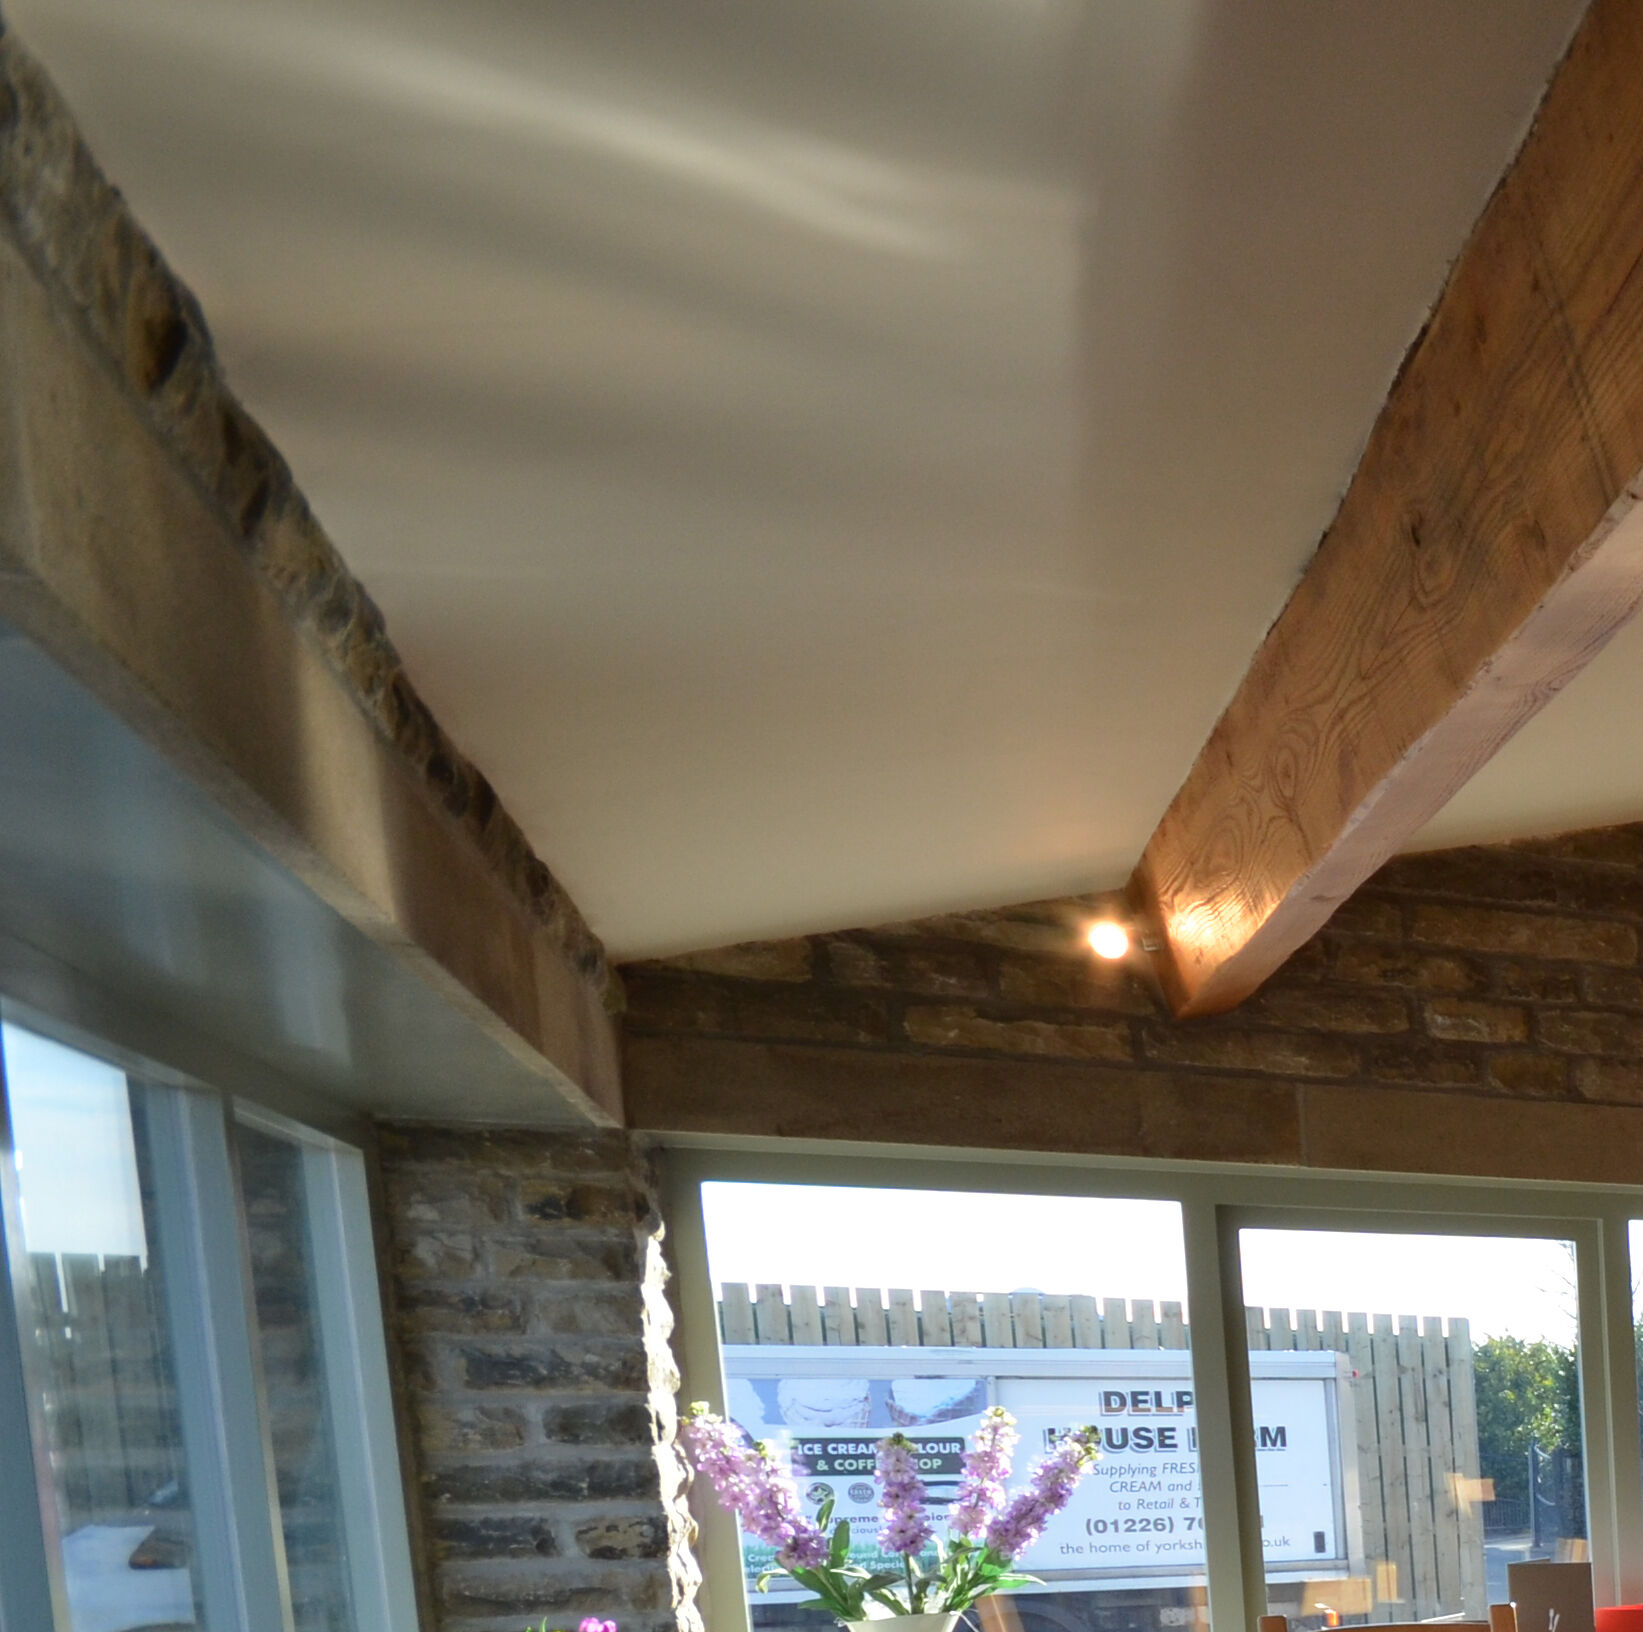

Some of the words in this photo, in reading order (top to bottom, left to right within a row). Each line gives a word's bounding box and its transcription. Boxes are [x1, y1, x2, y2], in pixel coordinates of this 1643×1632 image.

[1100, 1390, 1195, 1415] DELP
[798, 1443, 823, 1455] ICE
[816, 1459, 829, 1471] &
[1092, 1462, 1157, 1477] Supplying
[1162, 1462, 1198, 1474] FRES
[1109, 1480, 1162, 1492] CREAM
[1168, 1480, 1192, 1492] and
[1118, 1500, 1131, 1511] to
[1137, 1498, 1174, 1510] Retail
[1179, 1497, 1191, 1509] &
[1086, 1516, 1175, 1535] (01226)
[1060, 1543, 1084, 1555] the
[1090, 1541, 1132, 1554] home
[1136, 1540, 1151, 1553] of
